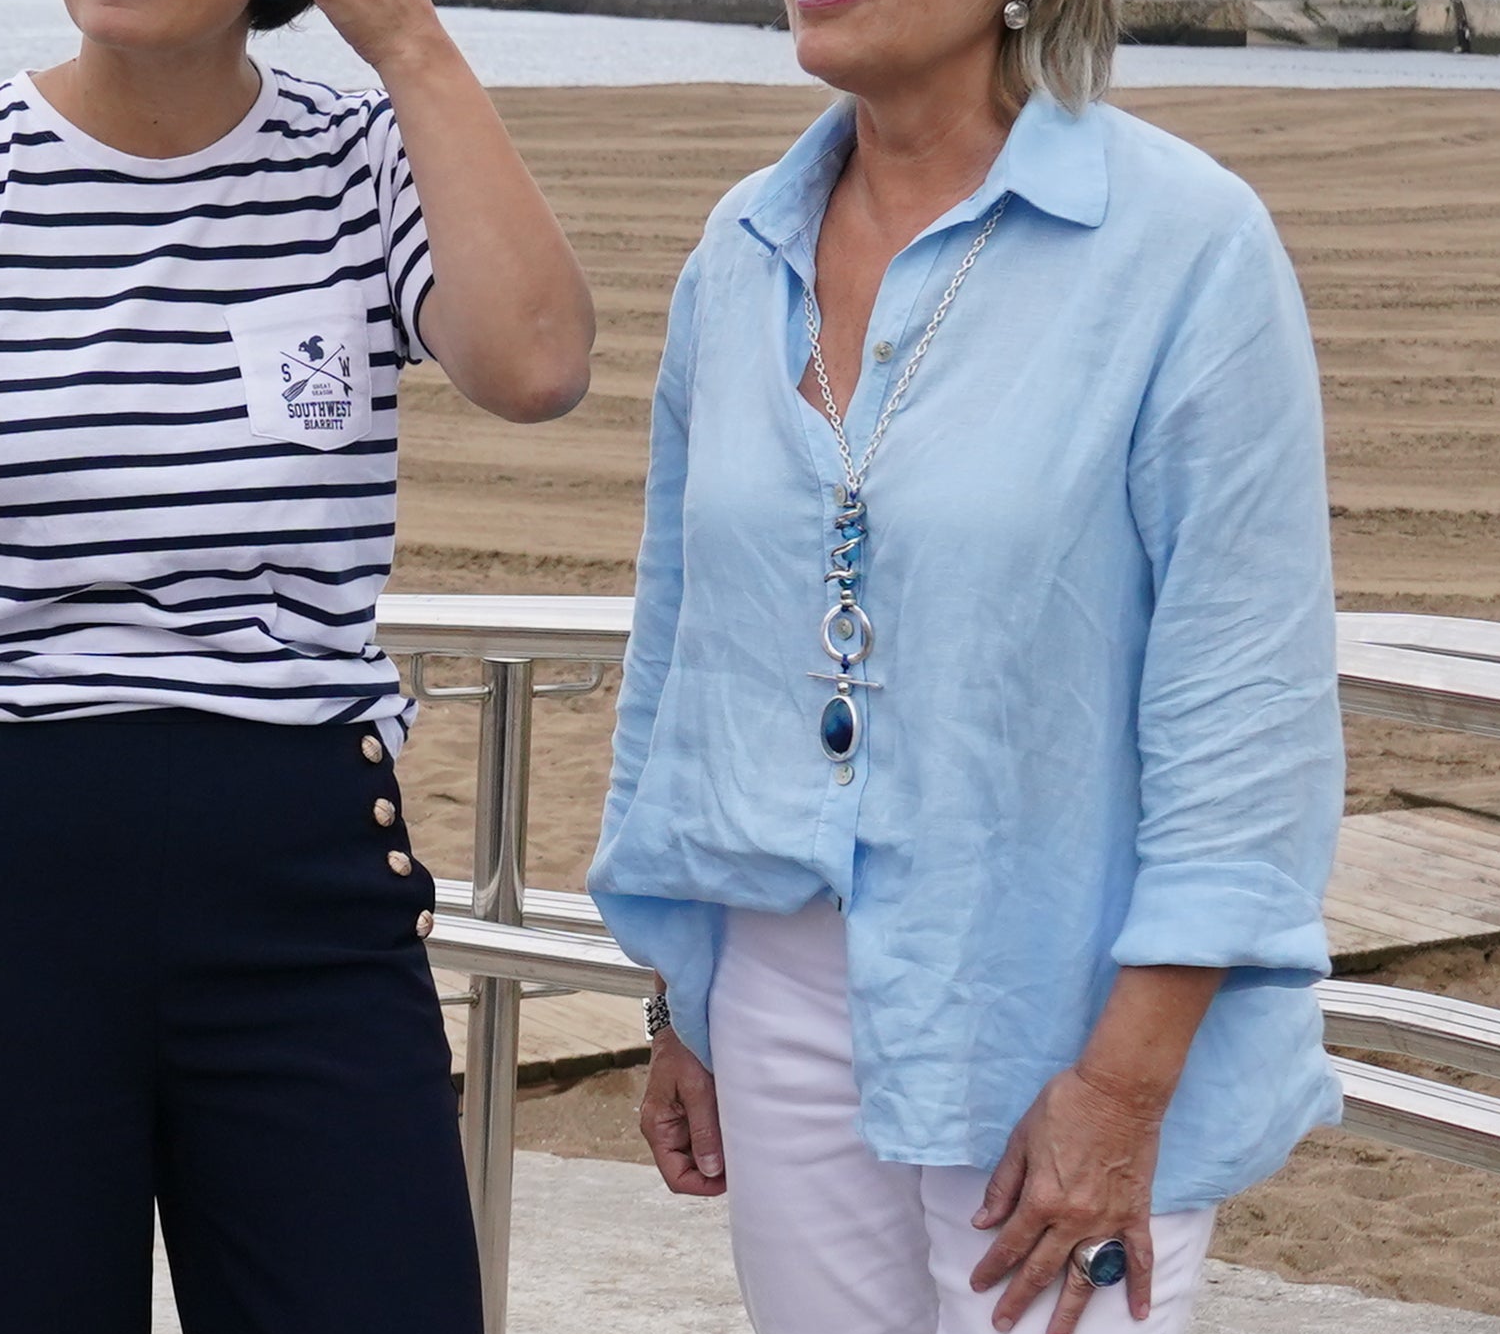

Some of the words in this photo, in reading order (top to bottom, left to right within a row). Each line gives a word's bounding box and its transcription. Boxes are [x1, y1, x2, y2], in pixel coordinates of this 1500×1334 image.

[281, 363, 292, 382] S
[338, 356, 351, 377] W
[287, 400, 352, 418] SOUTHWEST
[304, 419, 344, 430] BIARRITZ
